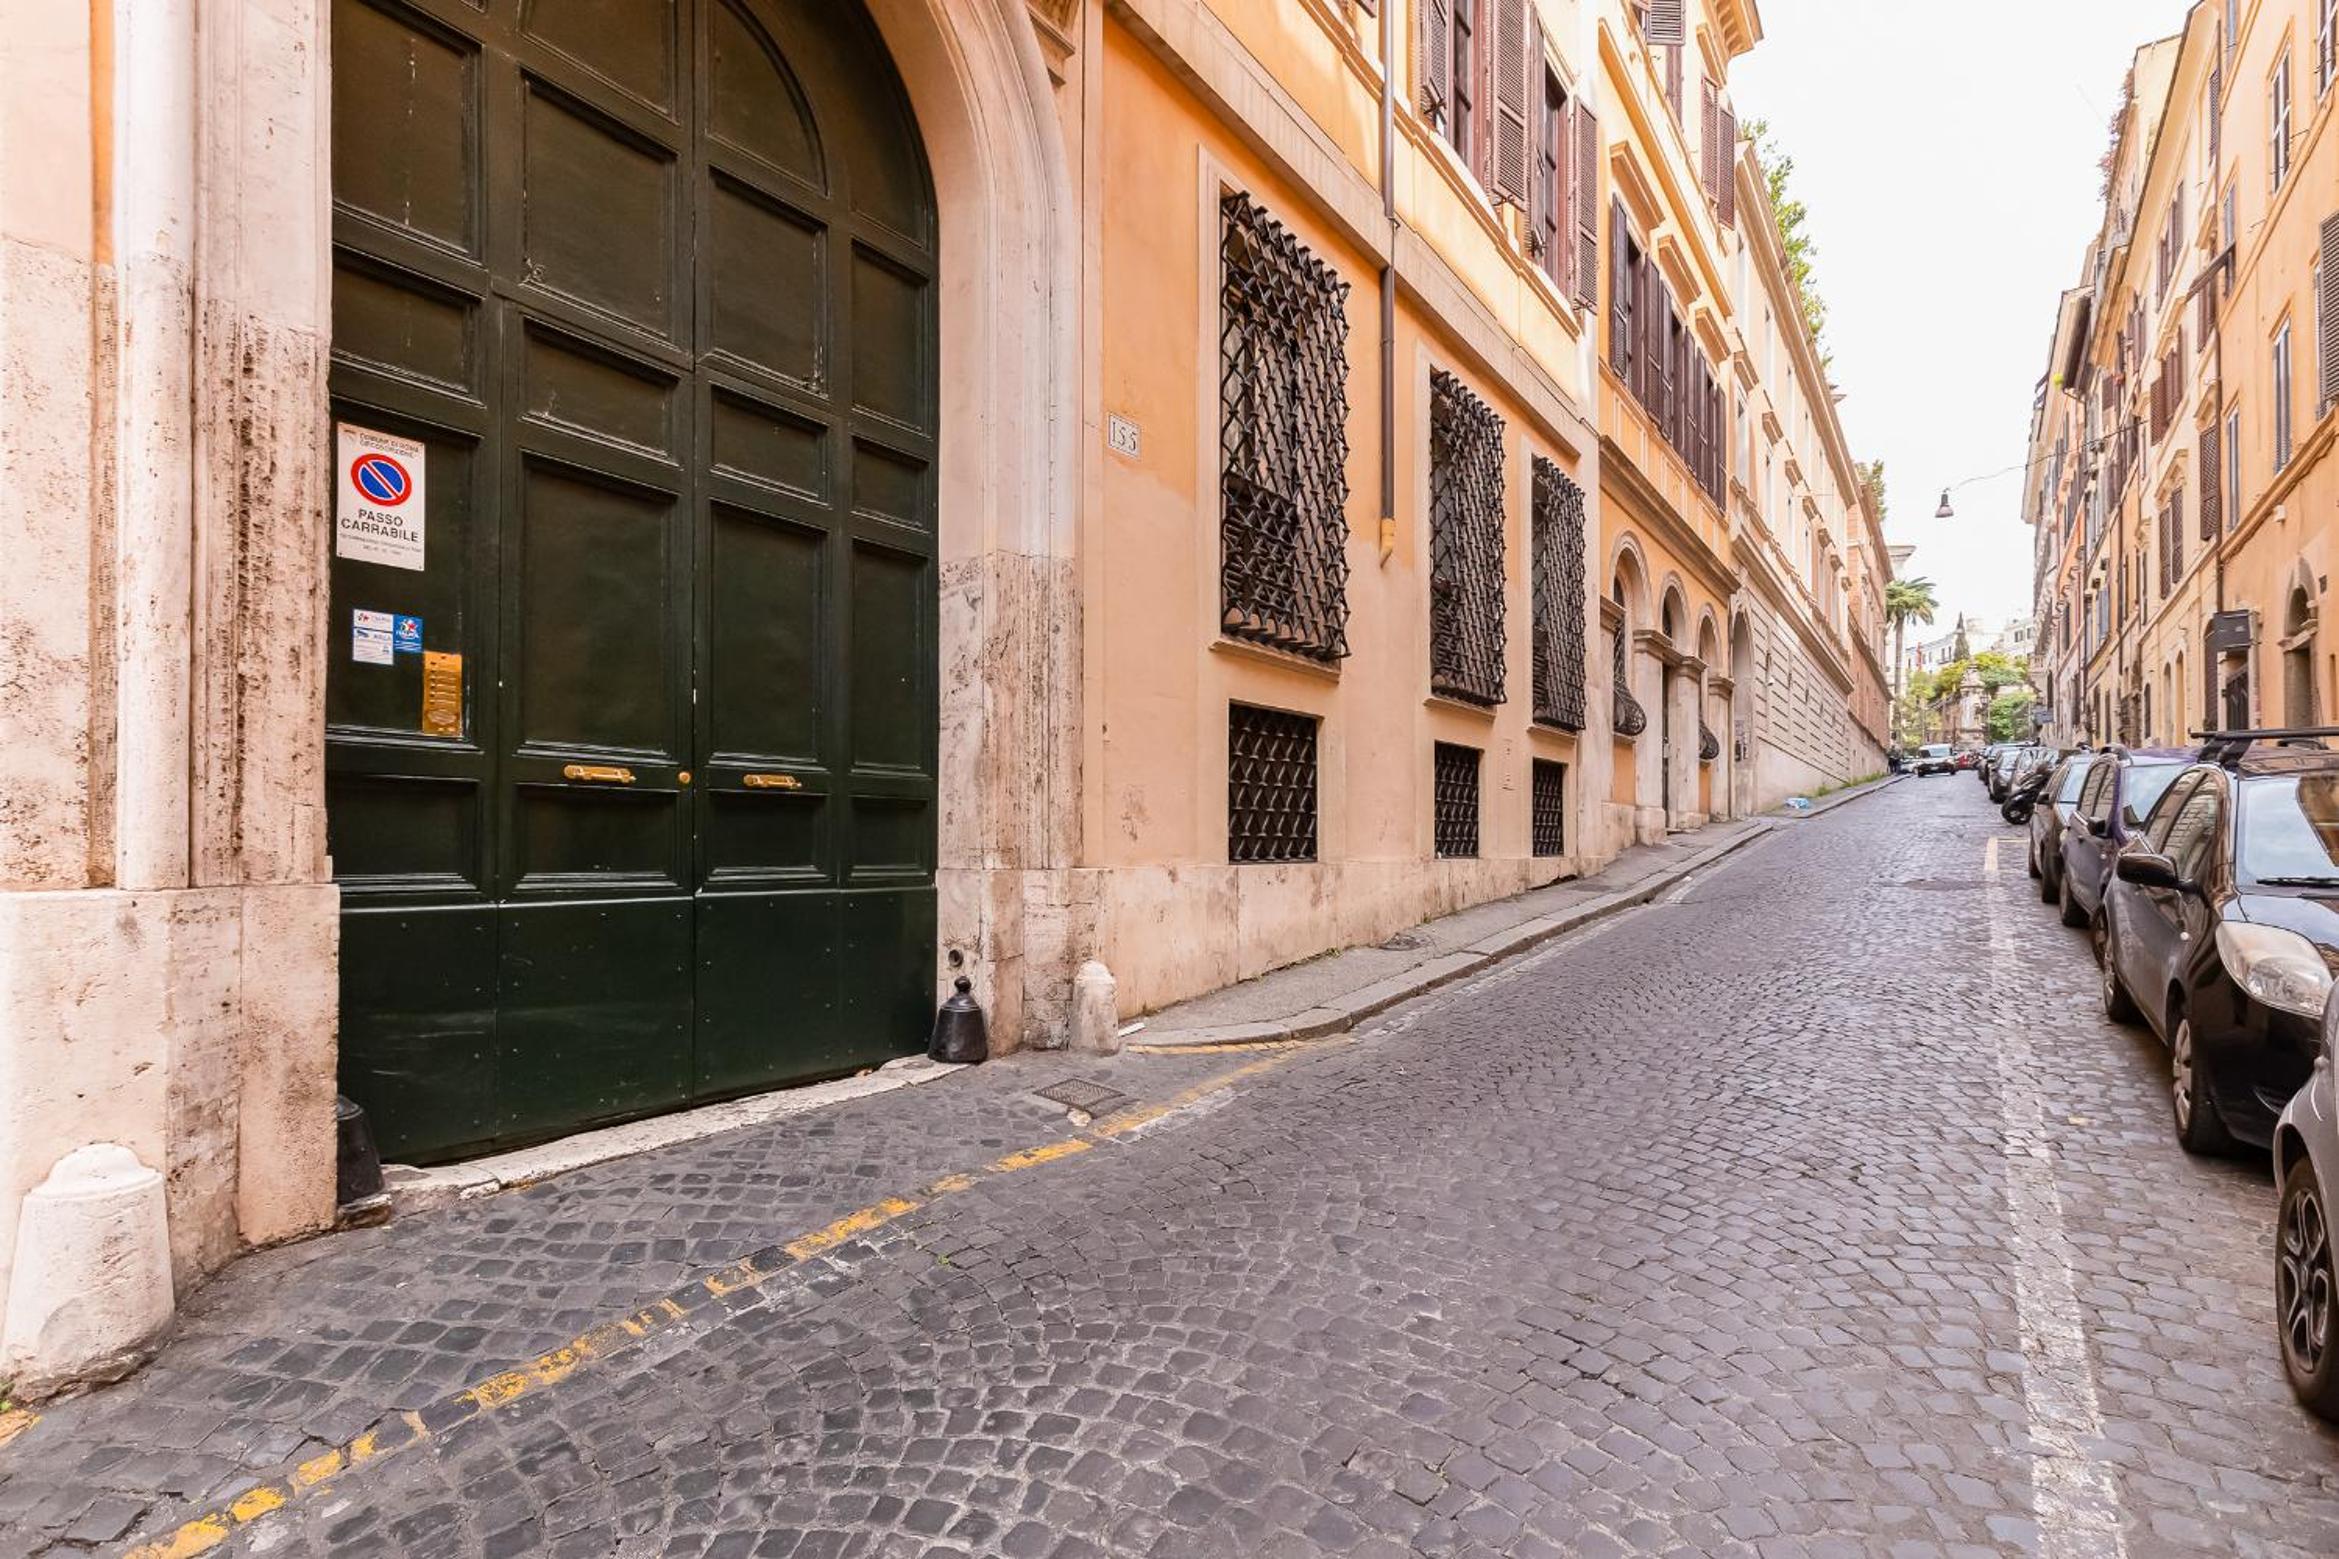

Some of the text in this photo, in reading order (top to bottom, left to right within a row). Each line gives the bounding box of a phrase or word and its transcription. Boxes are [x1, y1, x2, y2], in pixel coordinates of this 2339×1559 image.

[1112, 421, 1136, 451] 155
[341, 518, 419, 542] CARRABILE
[358, 509, 404, 527] PASSO
